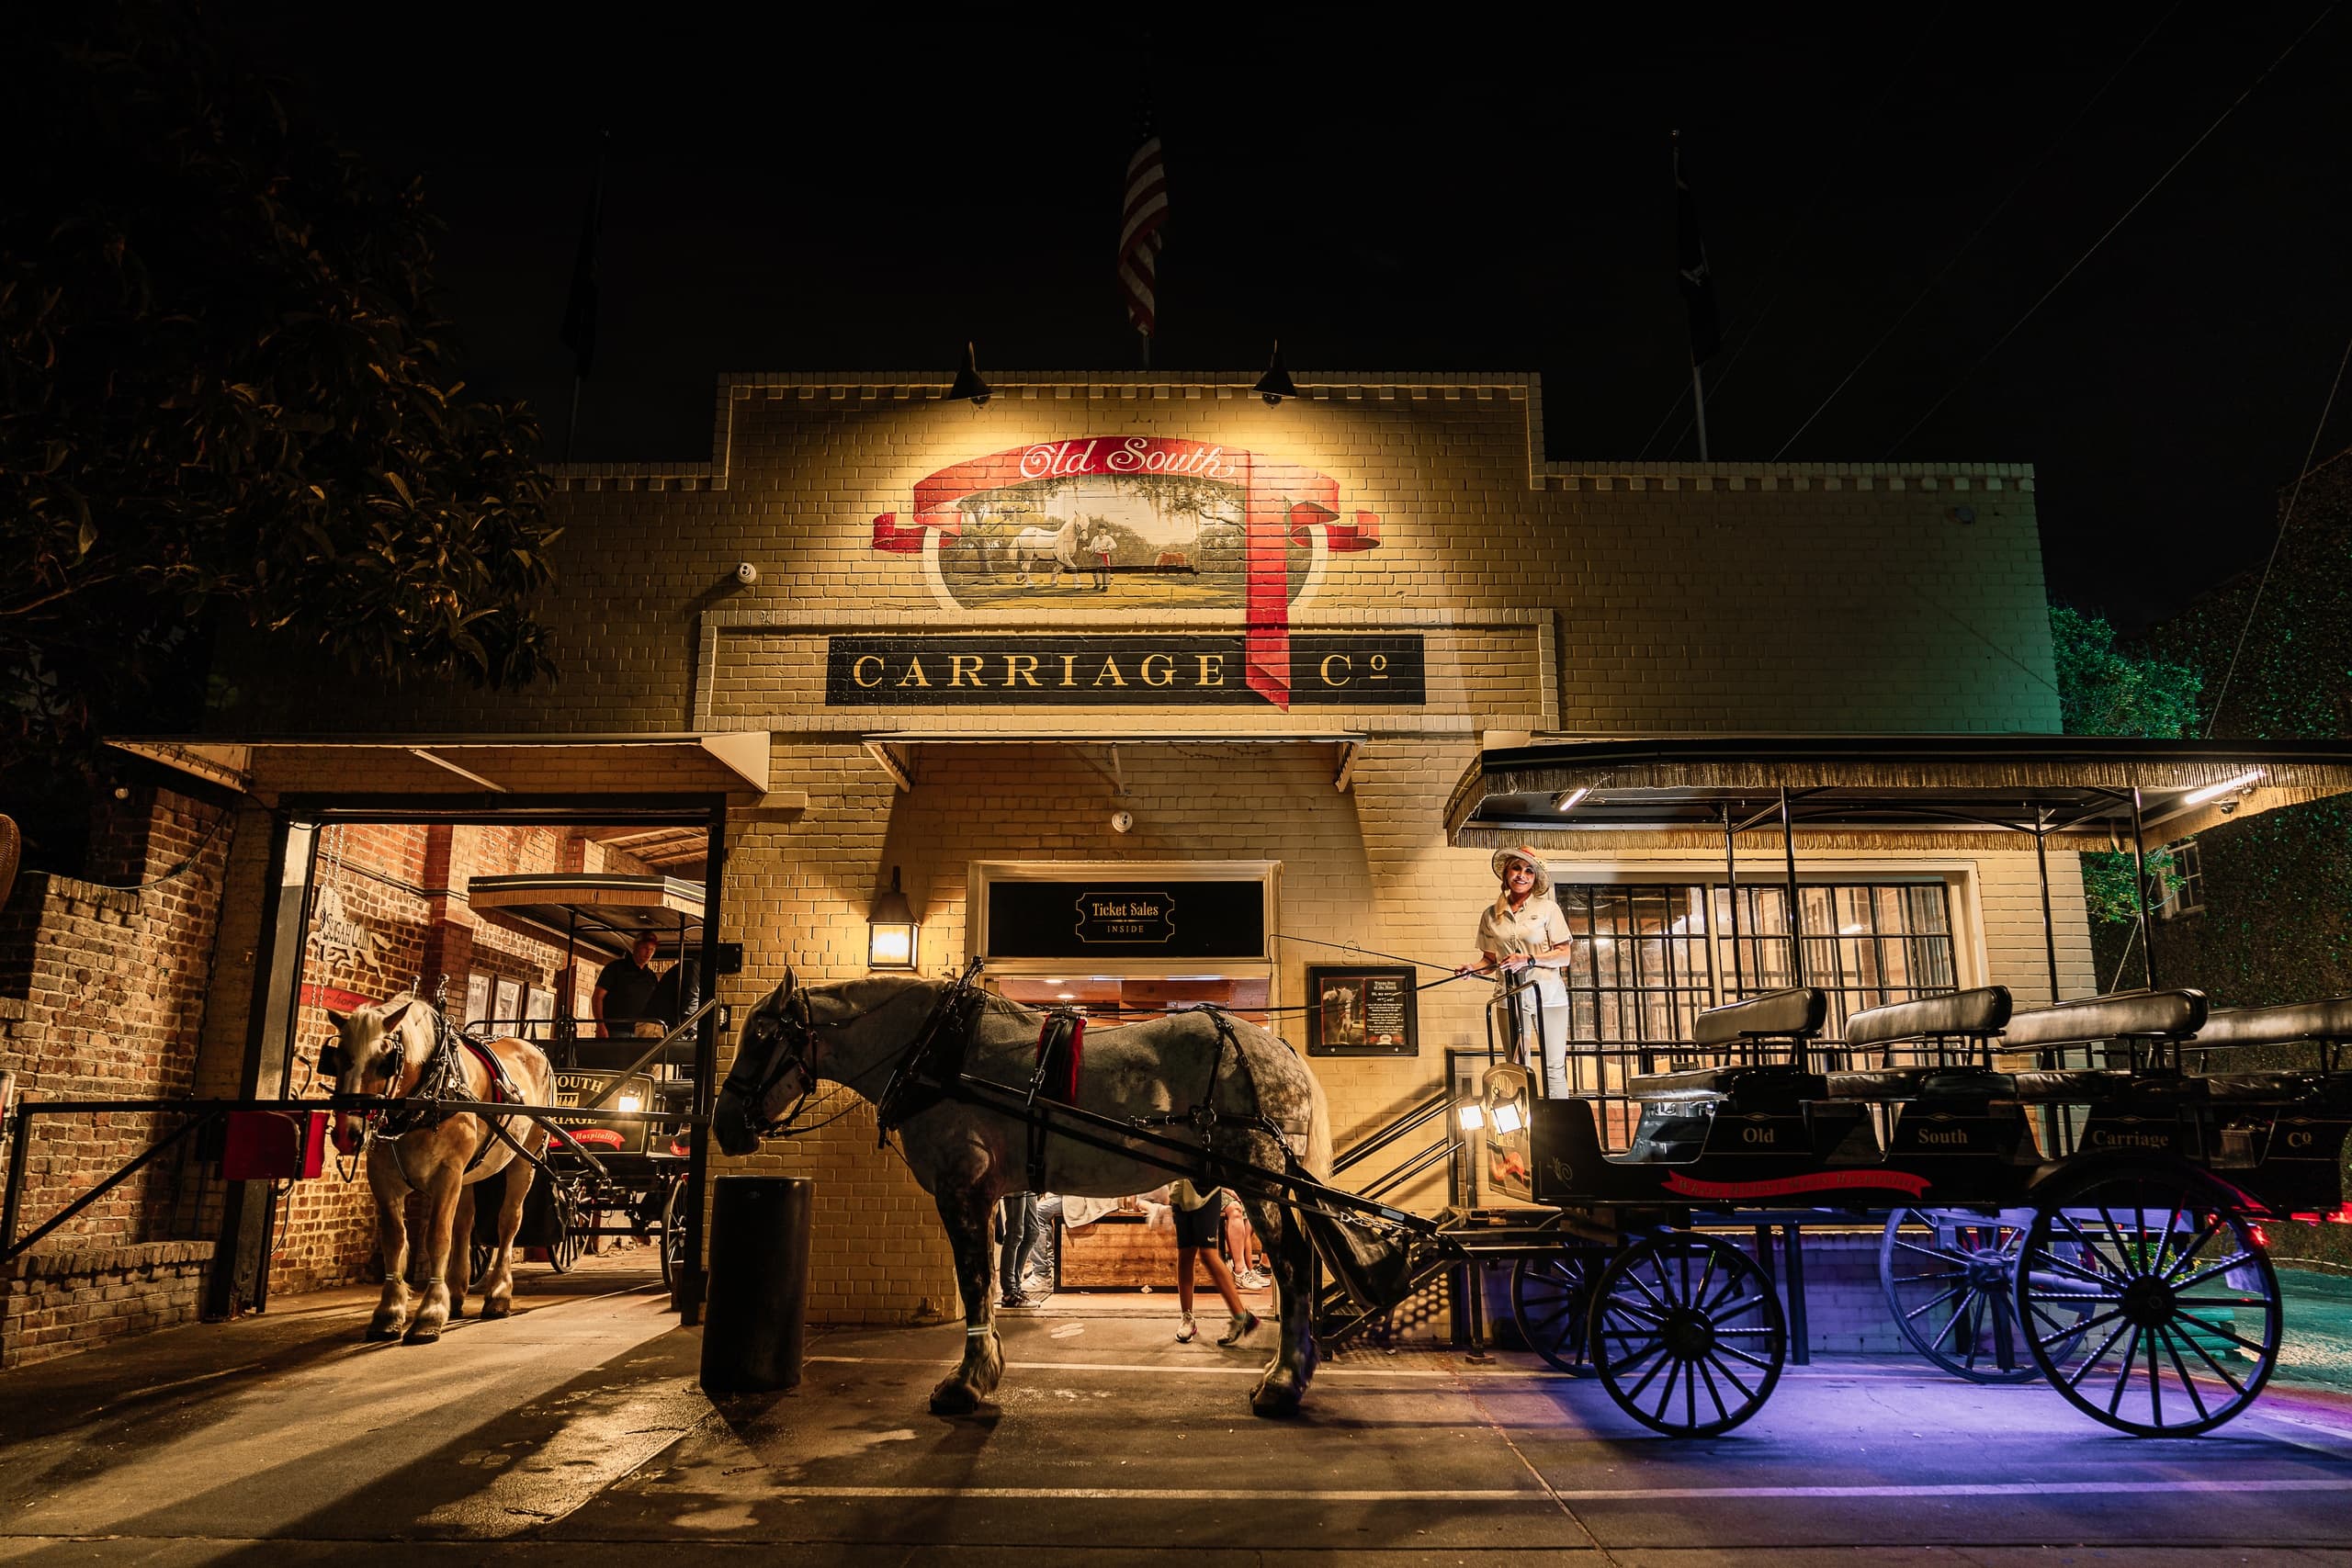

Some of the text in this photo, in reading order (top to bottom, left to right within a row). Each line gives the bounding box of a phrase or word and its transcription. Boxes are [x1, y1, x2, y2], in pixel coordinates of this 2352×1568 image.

[1019, 436, 1236, 479] Old South
[853, 653, 1226, 688] CARRIAGE
[1092, 902, 1159, 917] Ticket Sales
[323, 913, 352, 945] SUGAH
[1107, 925, 1145, 933] INSIDE
[556, 1076, 605, 1093] OUTH
[576, 1132, 617, 1142] Hospitality
[1742, 1128, 1775, 1143] Old
[1917, 1128, 1968, 1144] South
[2092, 1130, 2169, 1148] Carriage
